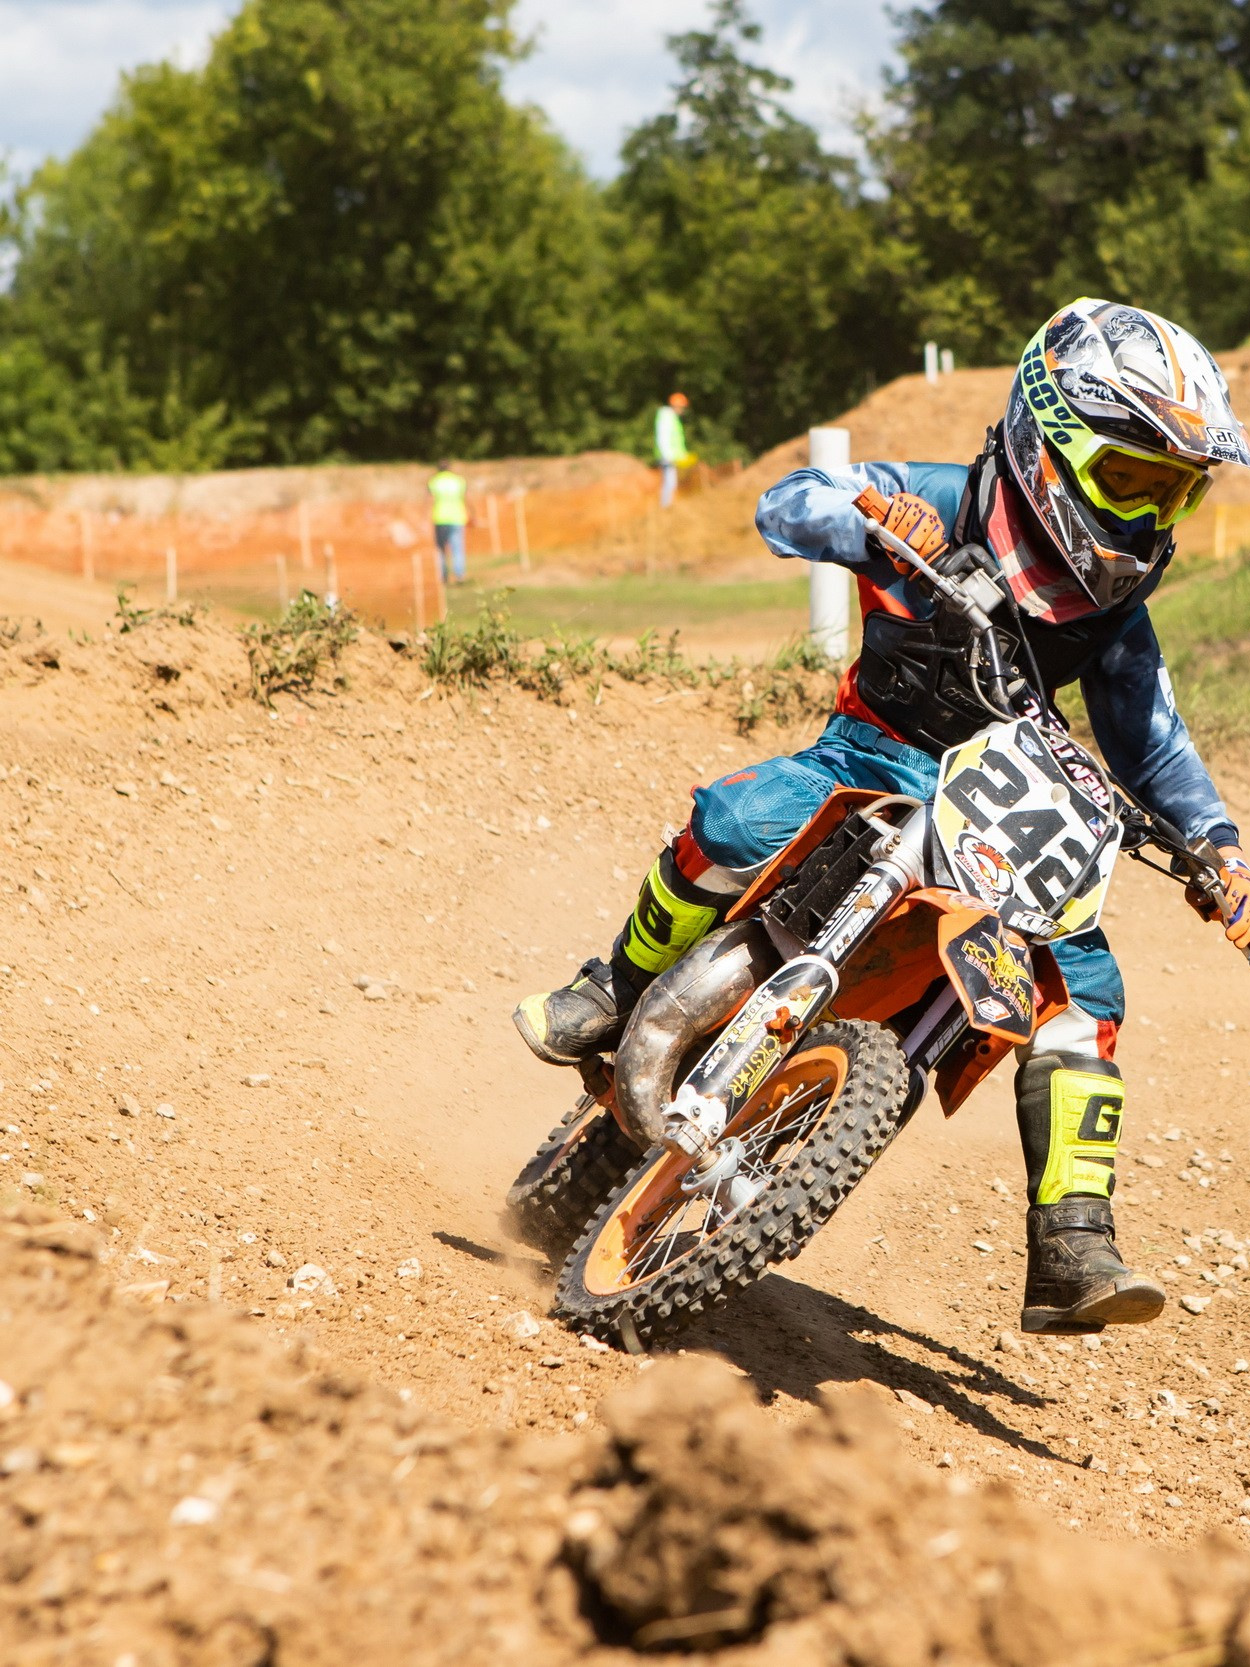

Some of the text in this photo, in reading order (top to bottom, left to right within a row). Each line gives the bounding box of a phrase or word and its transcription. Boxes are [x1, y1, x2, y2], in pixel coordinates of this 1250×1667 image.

[1023, 342, 1086, 445] 100%
[942, 748, 1101, 919] 242
[1008, 909, 1060, 939] KTM
[703, 986, 774, 1080] DUNLOP
[1078, 1096, 1122, 1141] G
